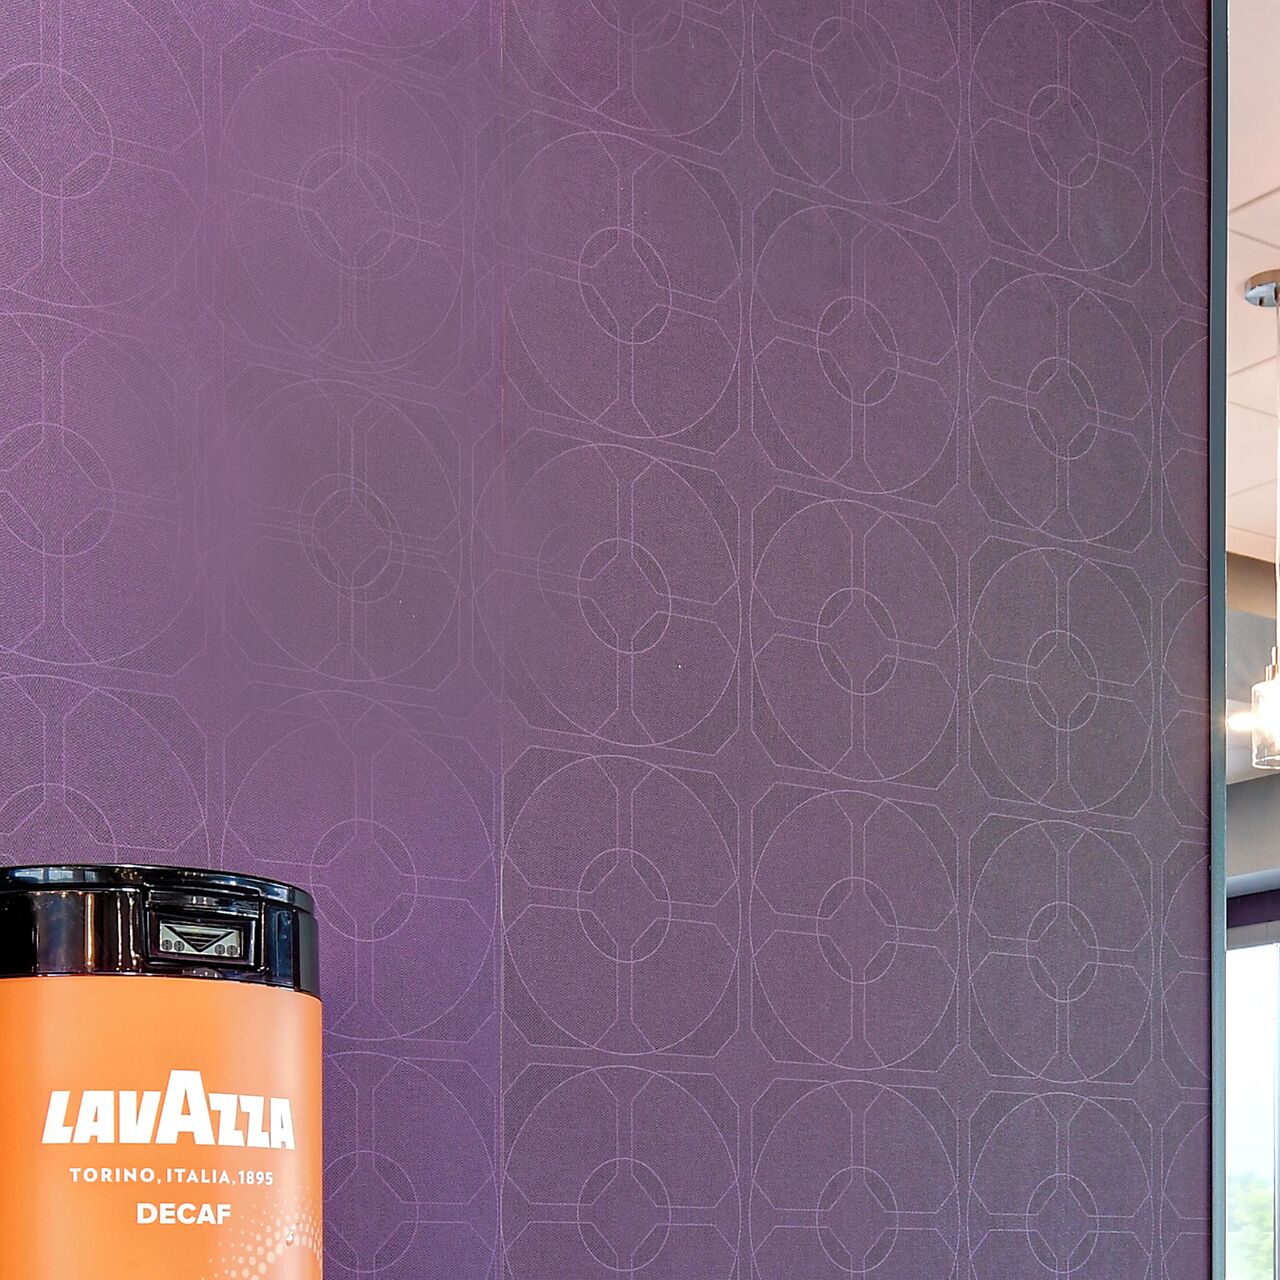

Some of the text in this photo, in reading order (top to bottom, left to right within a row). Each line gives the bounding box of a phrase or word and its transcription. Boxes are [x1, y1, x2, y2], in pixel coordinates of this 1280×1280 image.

[43, 1069, 296, 1151] LAVAZZA
[238, 1170, 273, 1186] 1895
[137, 1203, 231, 1225] DECAF
